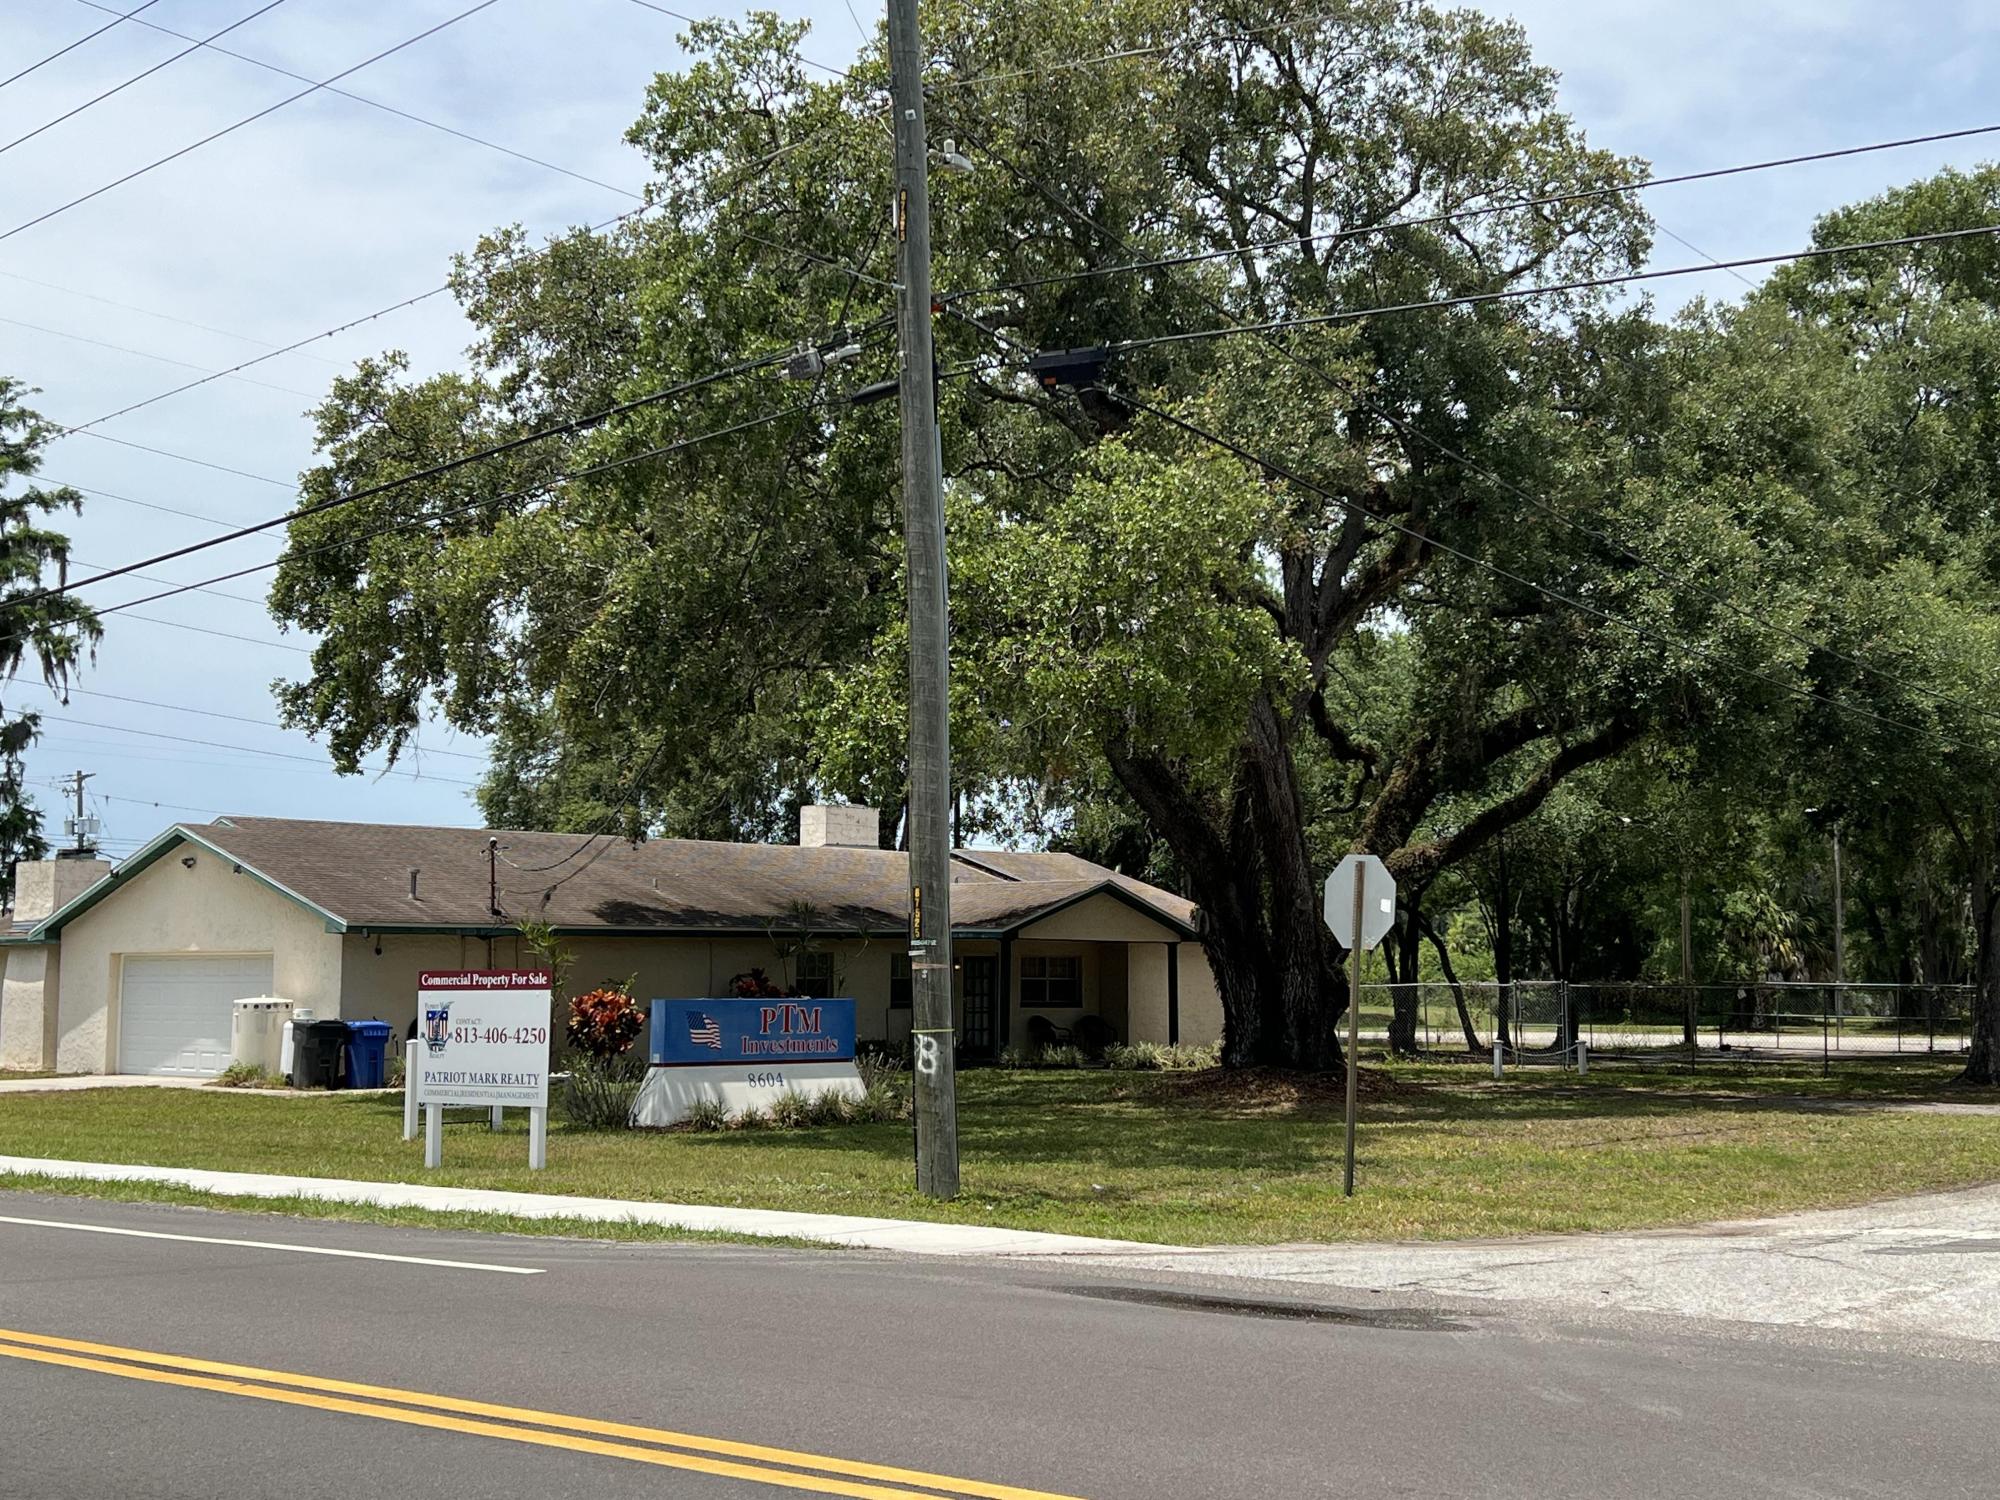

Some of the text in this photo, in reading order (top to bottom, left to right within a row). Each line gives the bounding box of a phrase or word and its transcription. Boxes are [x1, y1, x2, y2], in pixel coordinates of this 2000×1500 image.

[421, 972, 548, 989] Commercial Property For Sale
[760, 1003, 822, 1035] PTM
[454, 1027, 547, 1045] 813-406-4250
[741, 1035, 839, 1056] Investments
[424, 1071, 540, 1086] PATRIOT MARK REALTY
[747, 1072, 785, 1089] 8604
